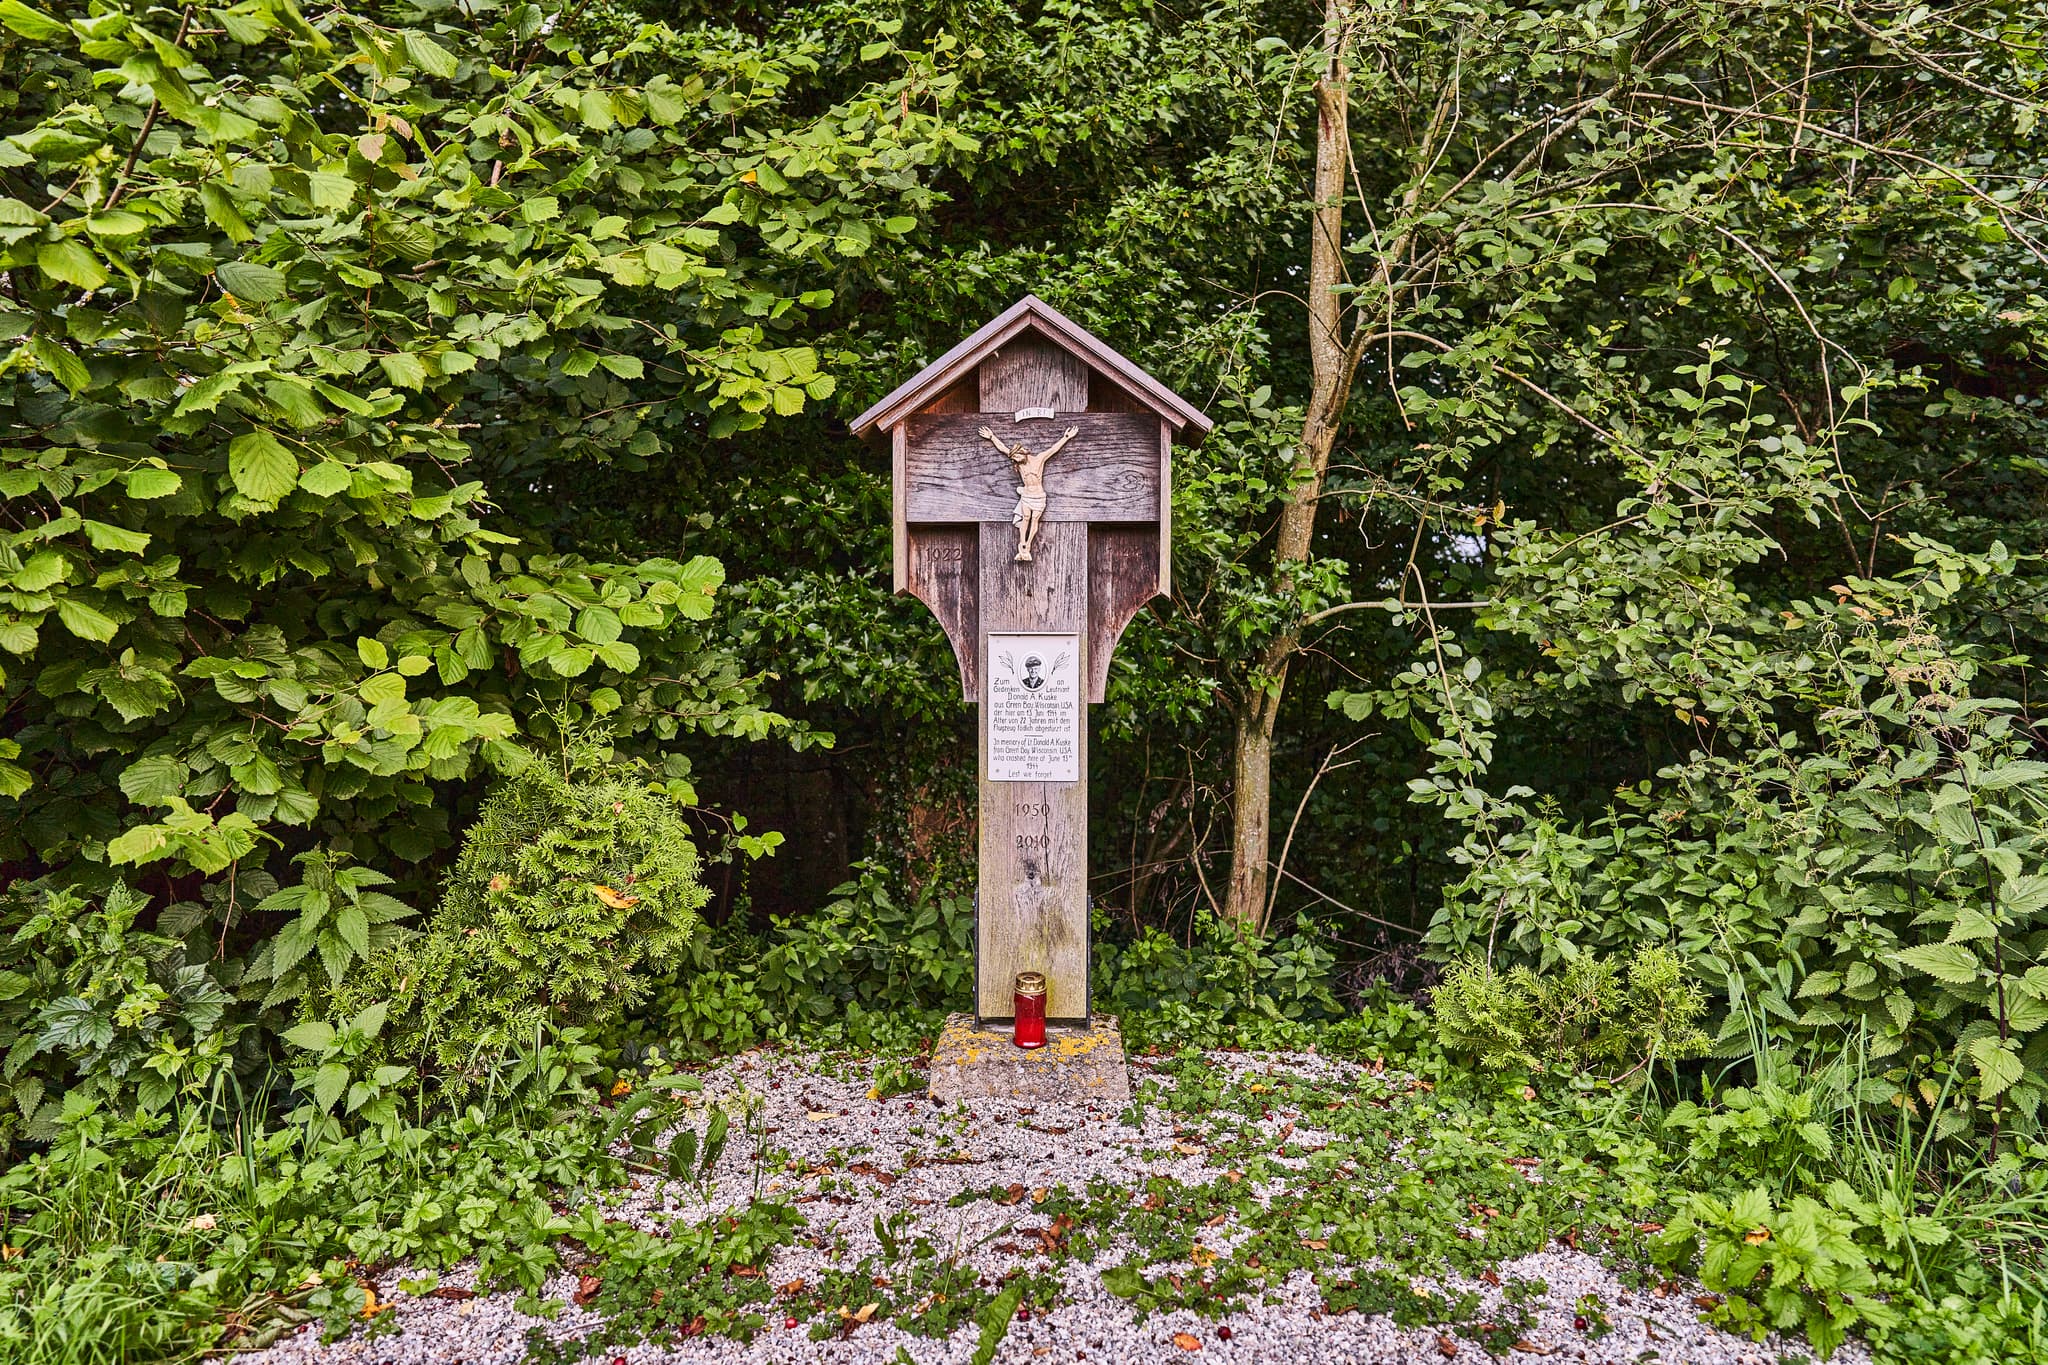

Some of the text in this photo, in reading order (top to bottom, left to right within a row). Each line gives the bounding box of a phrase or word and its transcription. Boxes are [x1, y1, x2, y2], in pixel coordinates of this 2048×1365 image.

[993, 677, 1010, 685] Zum
[993, 685, 1070, 693] Gedenken Leutnant
[1007, 692, 1029, 701] Donald
[1005, 700, 1022, 709] Green
[1060, 701, 1073, 709] USA
[1028, 717, 1046, 726] Jahren
[993, 724, 1016, 733] Flugzeug
[1000, 739, 1020, 747] memory
[1021, 738, 1027, 747] of
[1033, 738, 1049, 746] Donald
[993, 746, 1004, 754] from
[1059, 746, 1072, 754] USA
[1006, 754, 1026, 762] crashed
[1047, 754, 1060, 764] June
[1008, 769, 1020, 778] Lest
[1035, 769, 1052, 779] forget
[1015, 803, 1050, 817] 1950
[1015, 834, 1050, 849] 2010
